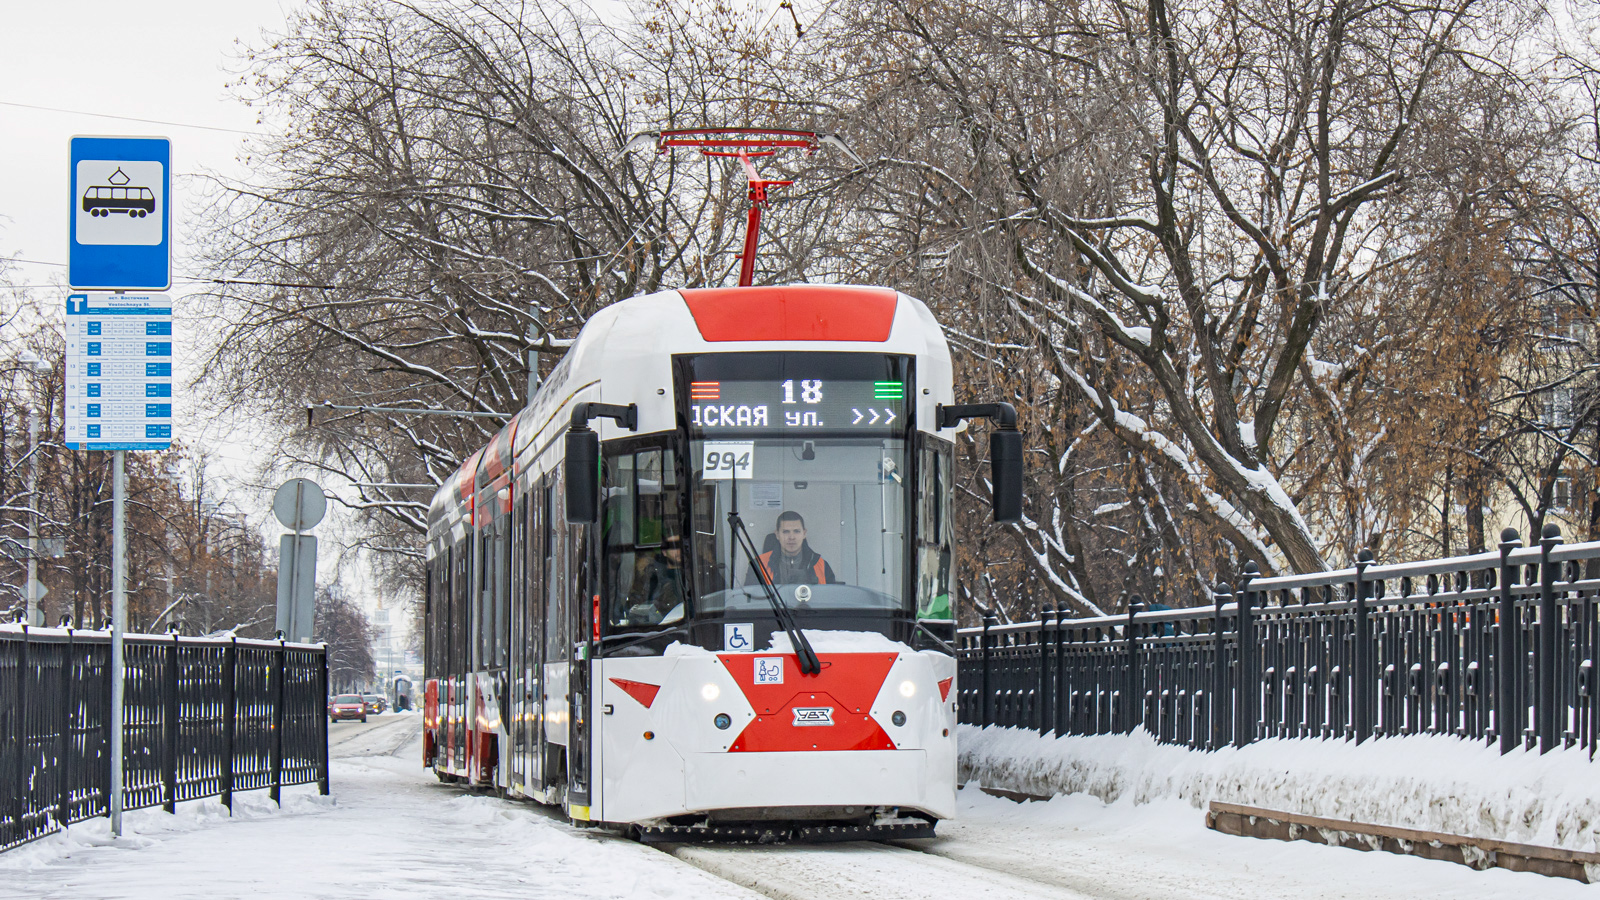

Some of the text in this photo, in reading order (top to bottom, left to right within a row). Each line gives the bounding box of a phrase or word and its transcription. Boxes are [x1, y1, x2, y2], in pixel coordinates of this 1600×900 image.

[782, 379, 823, 404] 18
[785, 411, 824, 426] ул.
[706, 452, 750, 470] 994
